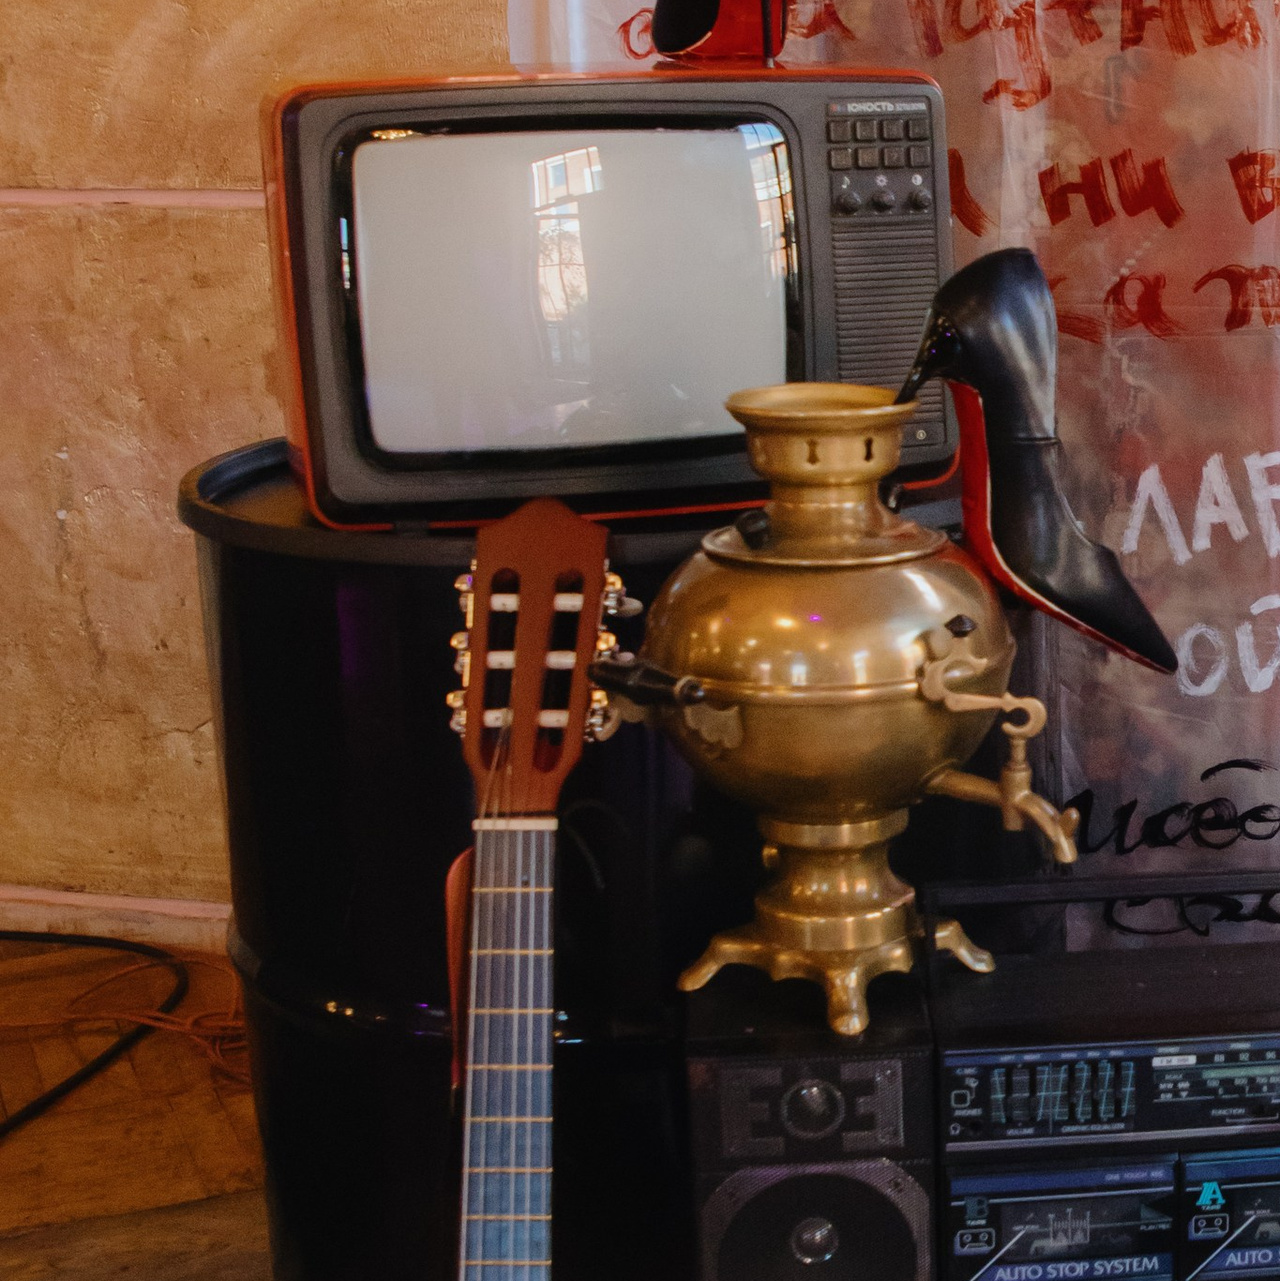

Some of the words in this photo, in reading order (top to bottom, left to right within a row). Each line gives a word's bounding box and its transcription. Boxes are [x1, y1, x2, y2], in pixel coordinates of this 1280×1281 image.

[847, 102, 895, 112] ЮНОСТЬ
[1226, 1250, 1273, 1267] AUTO
[994, 1263, 1043, 1281] AUTO
[1046, 1261, 1090, 1279] STOP
[1093, 1255, 1159, 1276] SYSTEM
